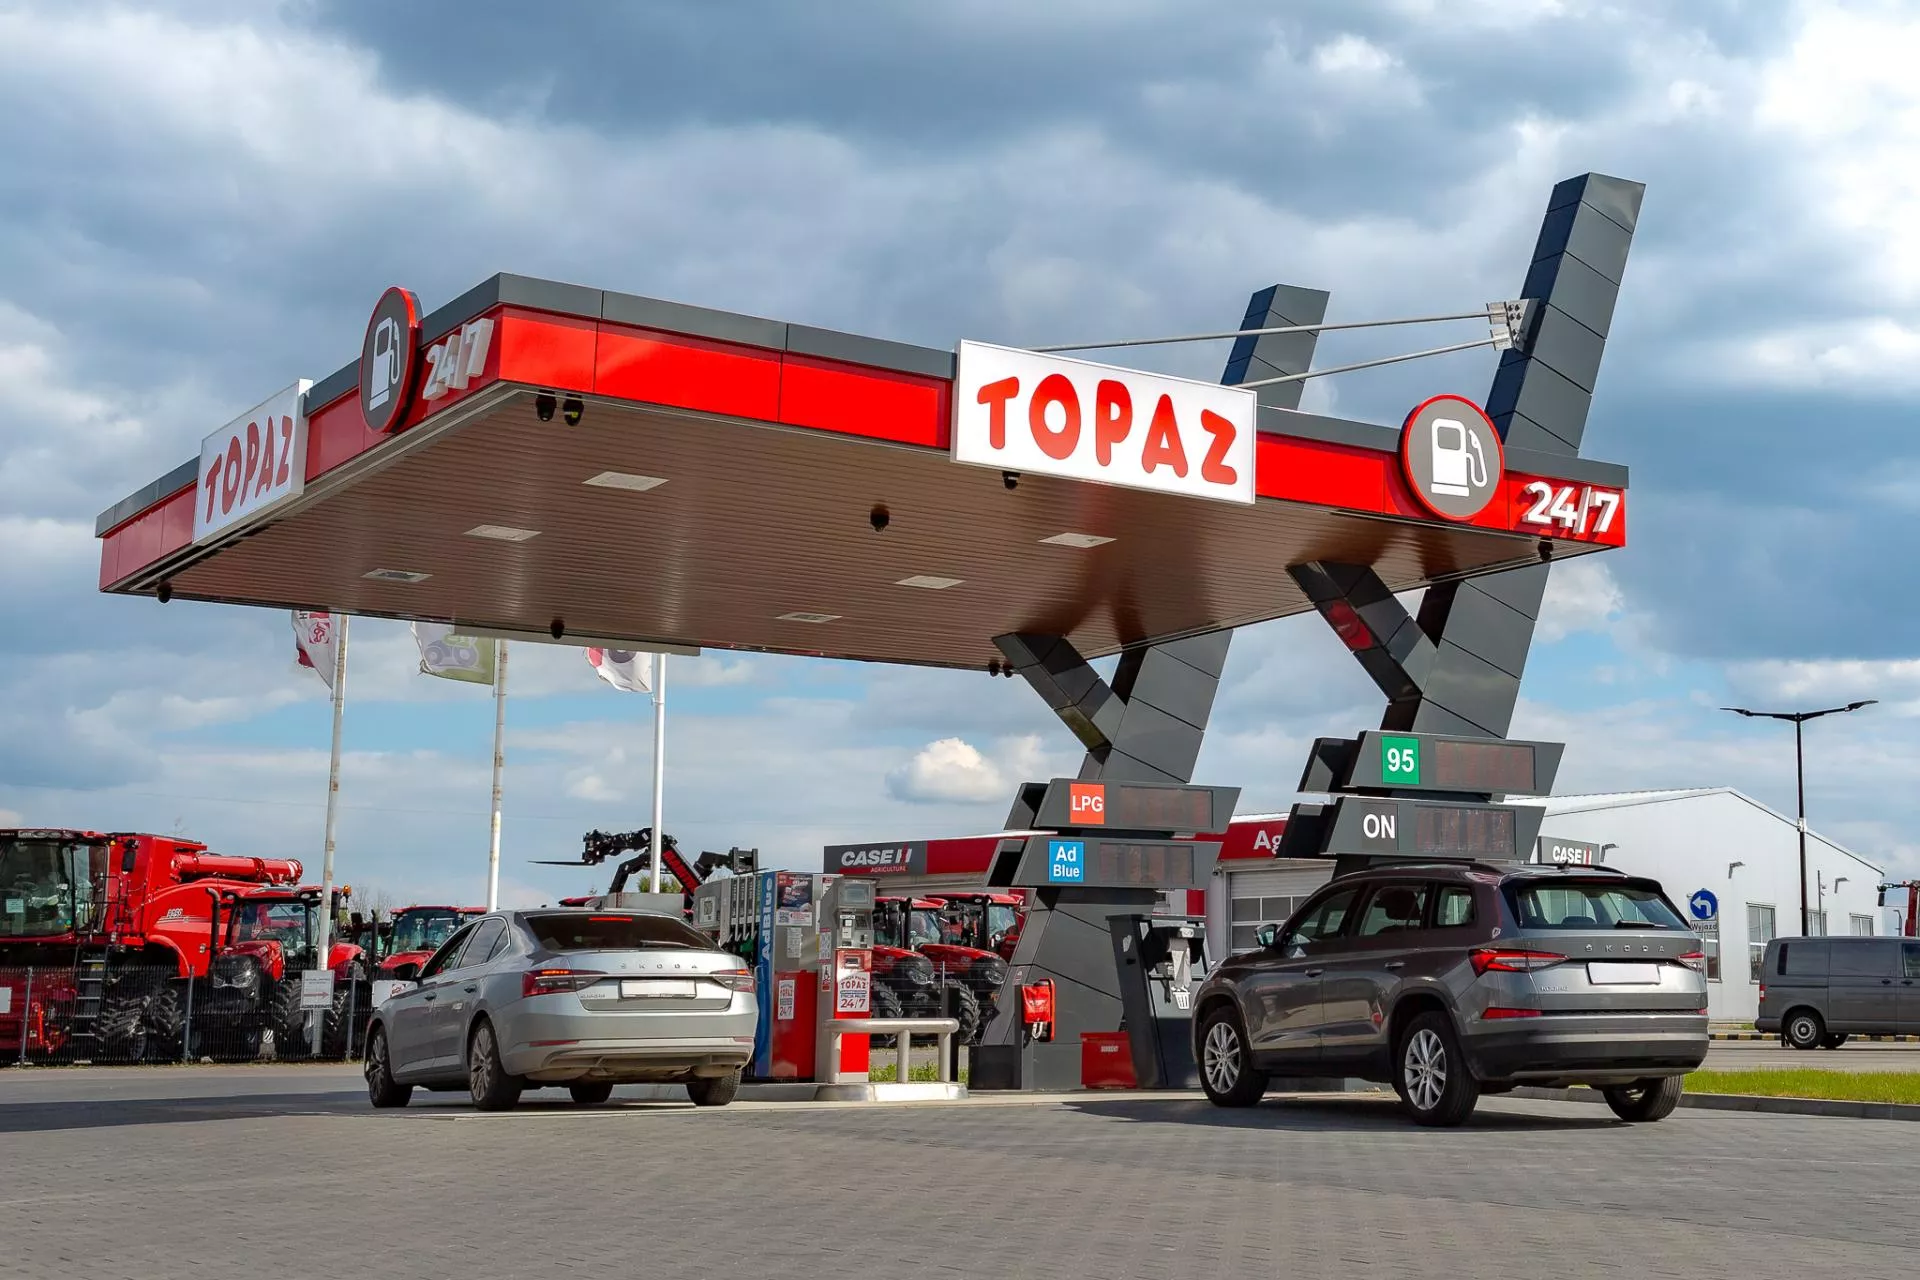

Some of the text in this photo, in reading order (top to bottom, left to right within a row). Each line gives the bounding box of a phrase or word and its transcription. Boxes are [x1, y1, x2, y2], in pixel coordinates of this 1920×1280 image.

[422, 317, 495, 401] 24/7
[977, 373, 1238, 486] TOPAZ
[205, 414, 294, 525] TOPAZ
[1522, 480, 1620, 534] 24/7
[1387, 747, 1415, 773] 95
[1071, 791, 1104, 813] LPG
[1363, 813, 1396, 839] ON
[841, 849, 894, 867] CASE
[1056, 846, 1077, 862] Ad
[1552, 845, 1582, 865] CASE
[870, 865, 906, 873] AGRICULTURE
[1053, 864, 1080, 878] Blue
[761, 877, 773, 961] AdBlue
[840, 980, 867, 990] TOPAZ
[840, 998, 866, 1009] 24/7
